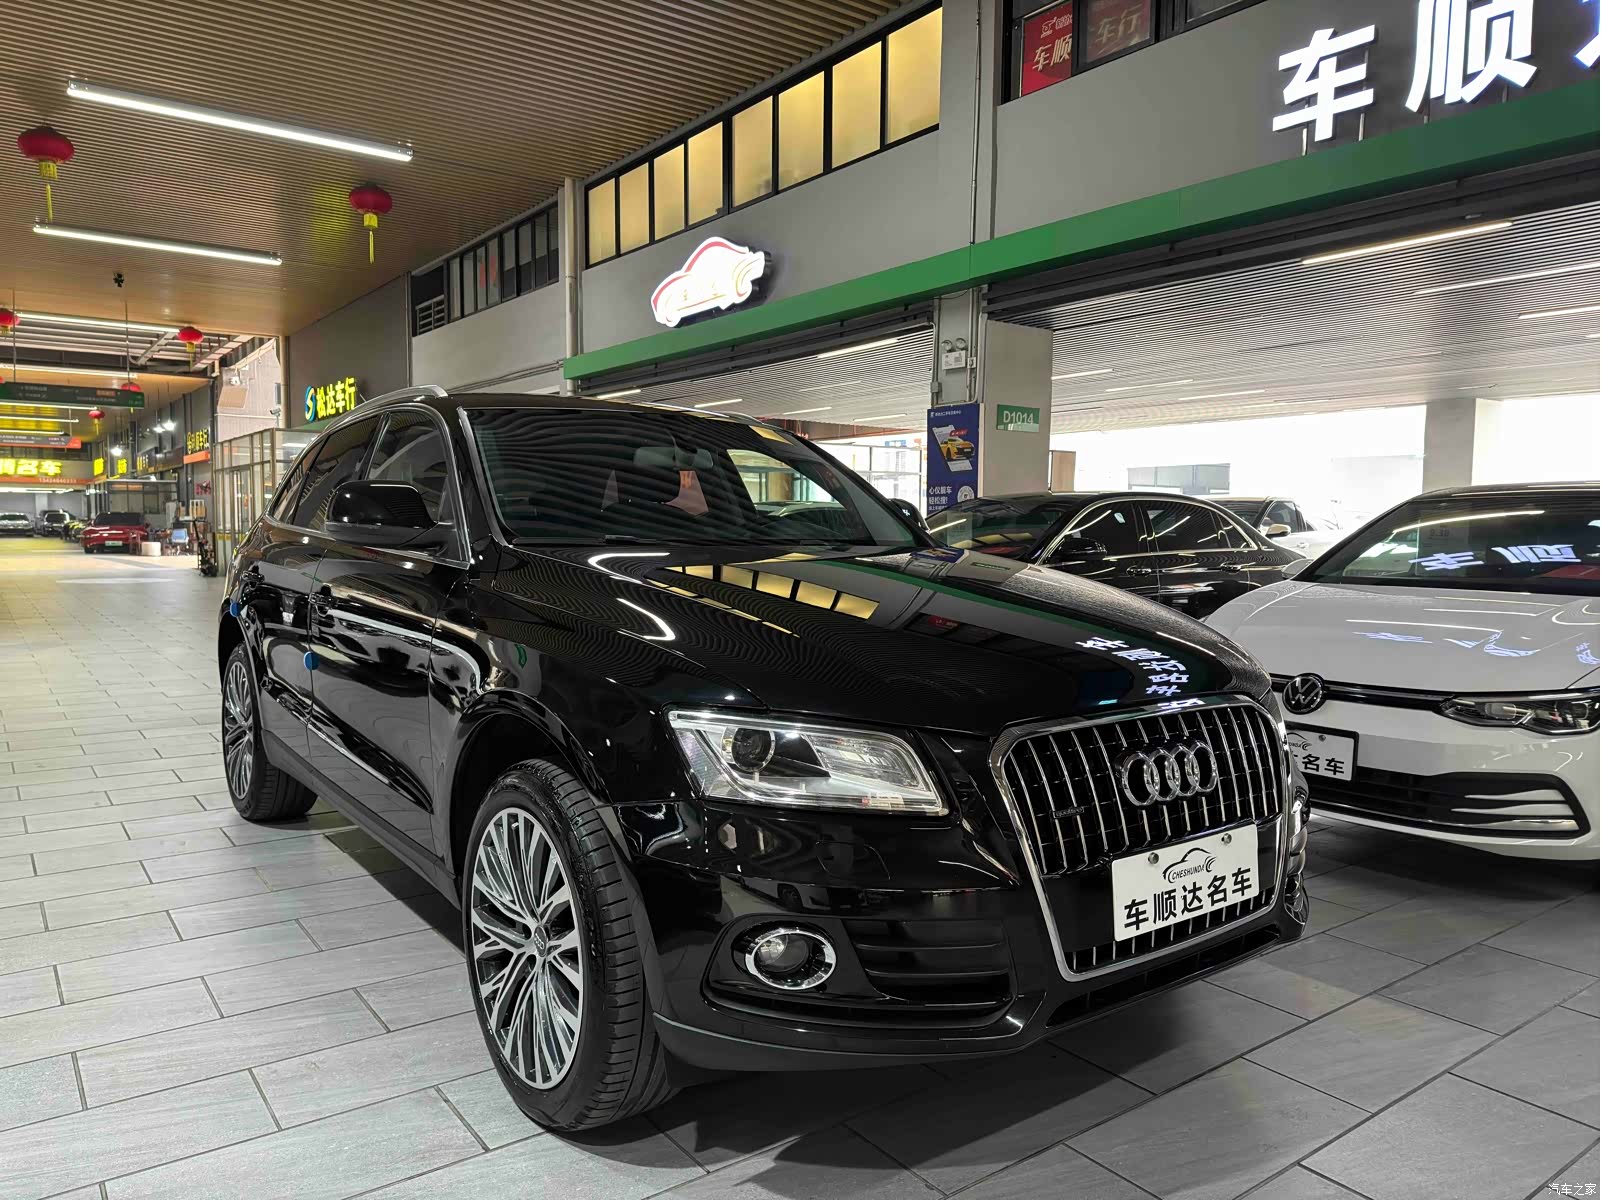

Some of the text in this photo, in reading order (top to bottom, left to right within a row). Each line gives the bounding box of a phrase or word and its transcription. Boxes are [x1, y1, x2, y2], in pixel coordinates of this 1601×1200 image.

[1003, 411, 1034, 425] D1014
[1293, 753, 1345, 775] 名车
[1171, 864, 1206, 880] CHESHUNDA
[1123, 867, 1253, 931] 车顺达名车
